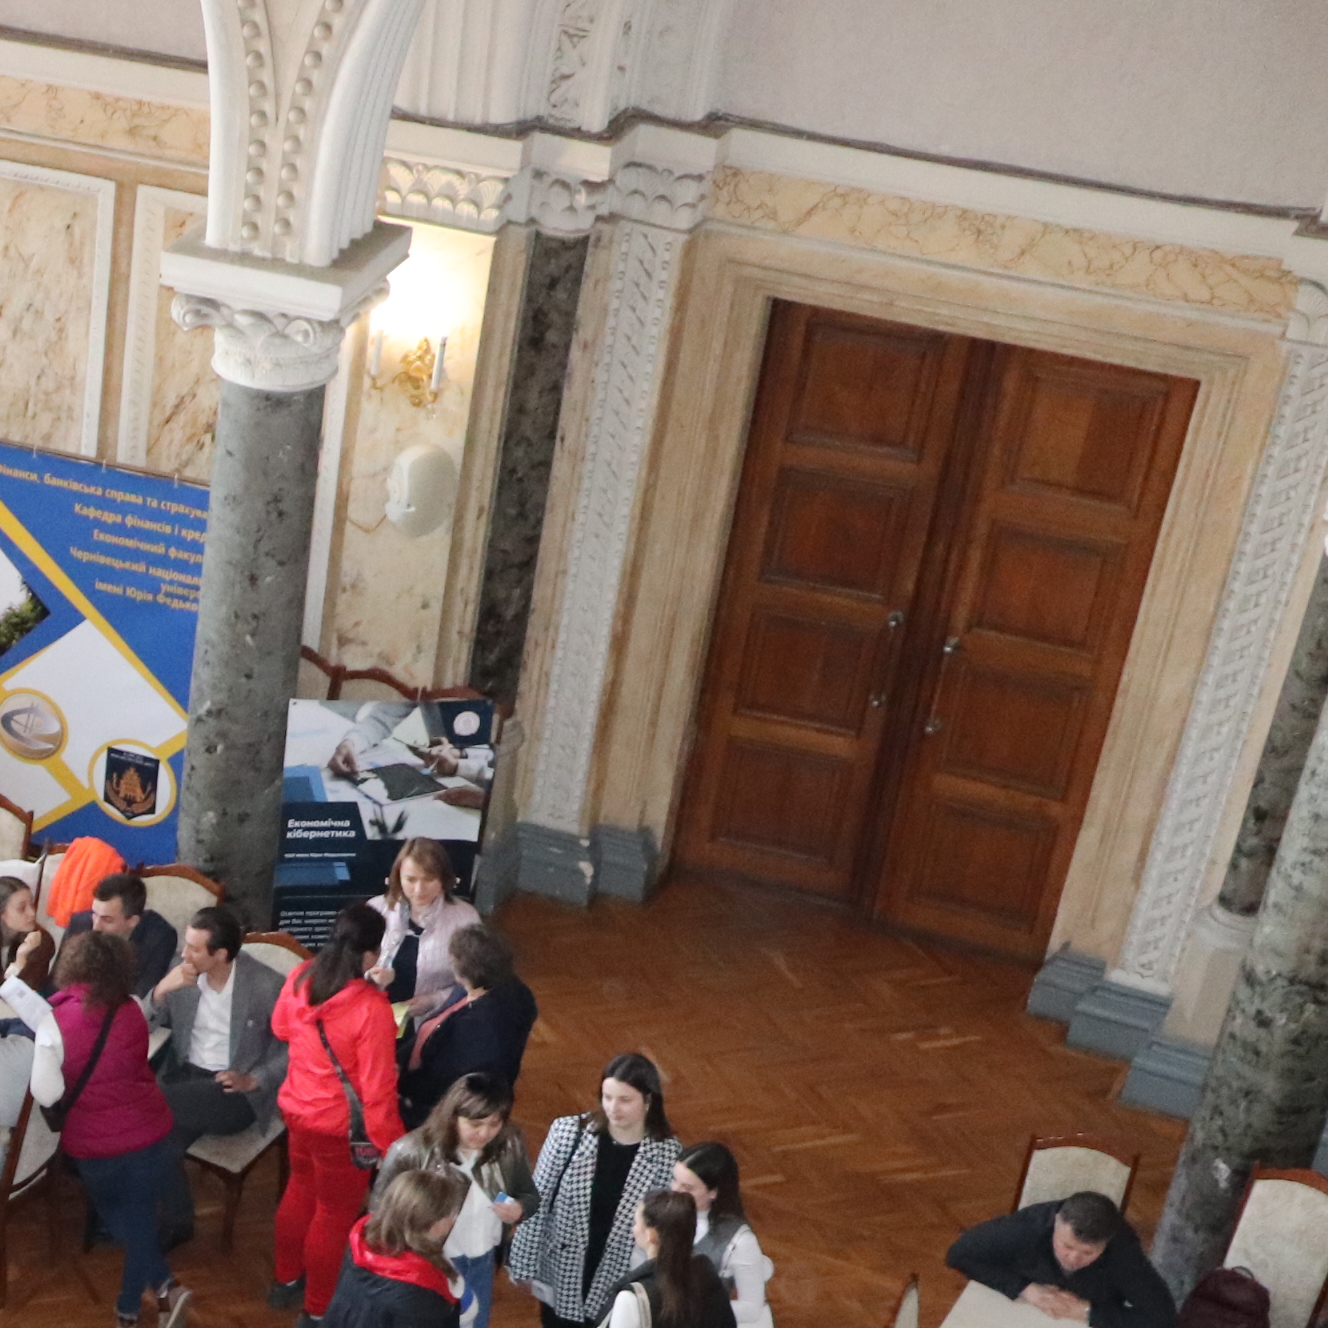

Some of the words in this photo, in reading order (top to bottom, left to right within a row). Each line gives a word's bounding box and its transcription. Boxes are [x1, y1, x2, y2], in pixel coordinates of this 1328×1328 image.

[44, 472, 103, 496] банківська
[105, 487, 144, 504] справа
[146, 496, 158, 508] та
[74, 502, 122, 524] Кафедра
[124, 513, 172, 534] фінансів
[93, 528, 166, 555] Економічний
[69, 546, 147, 573] Чернівецький
[95, 577, 124, 594] імені
[126, 586, 154, 602] Юрія
[286, 828, 356, 840] кібернетика
[287, 818, 351, 828] Економічна
